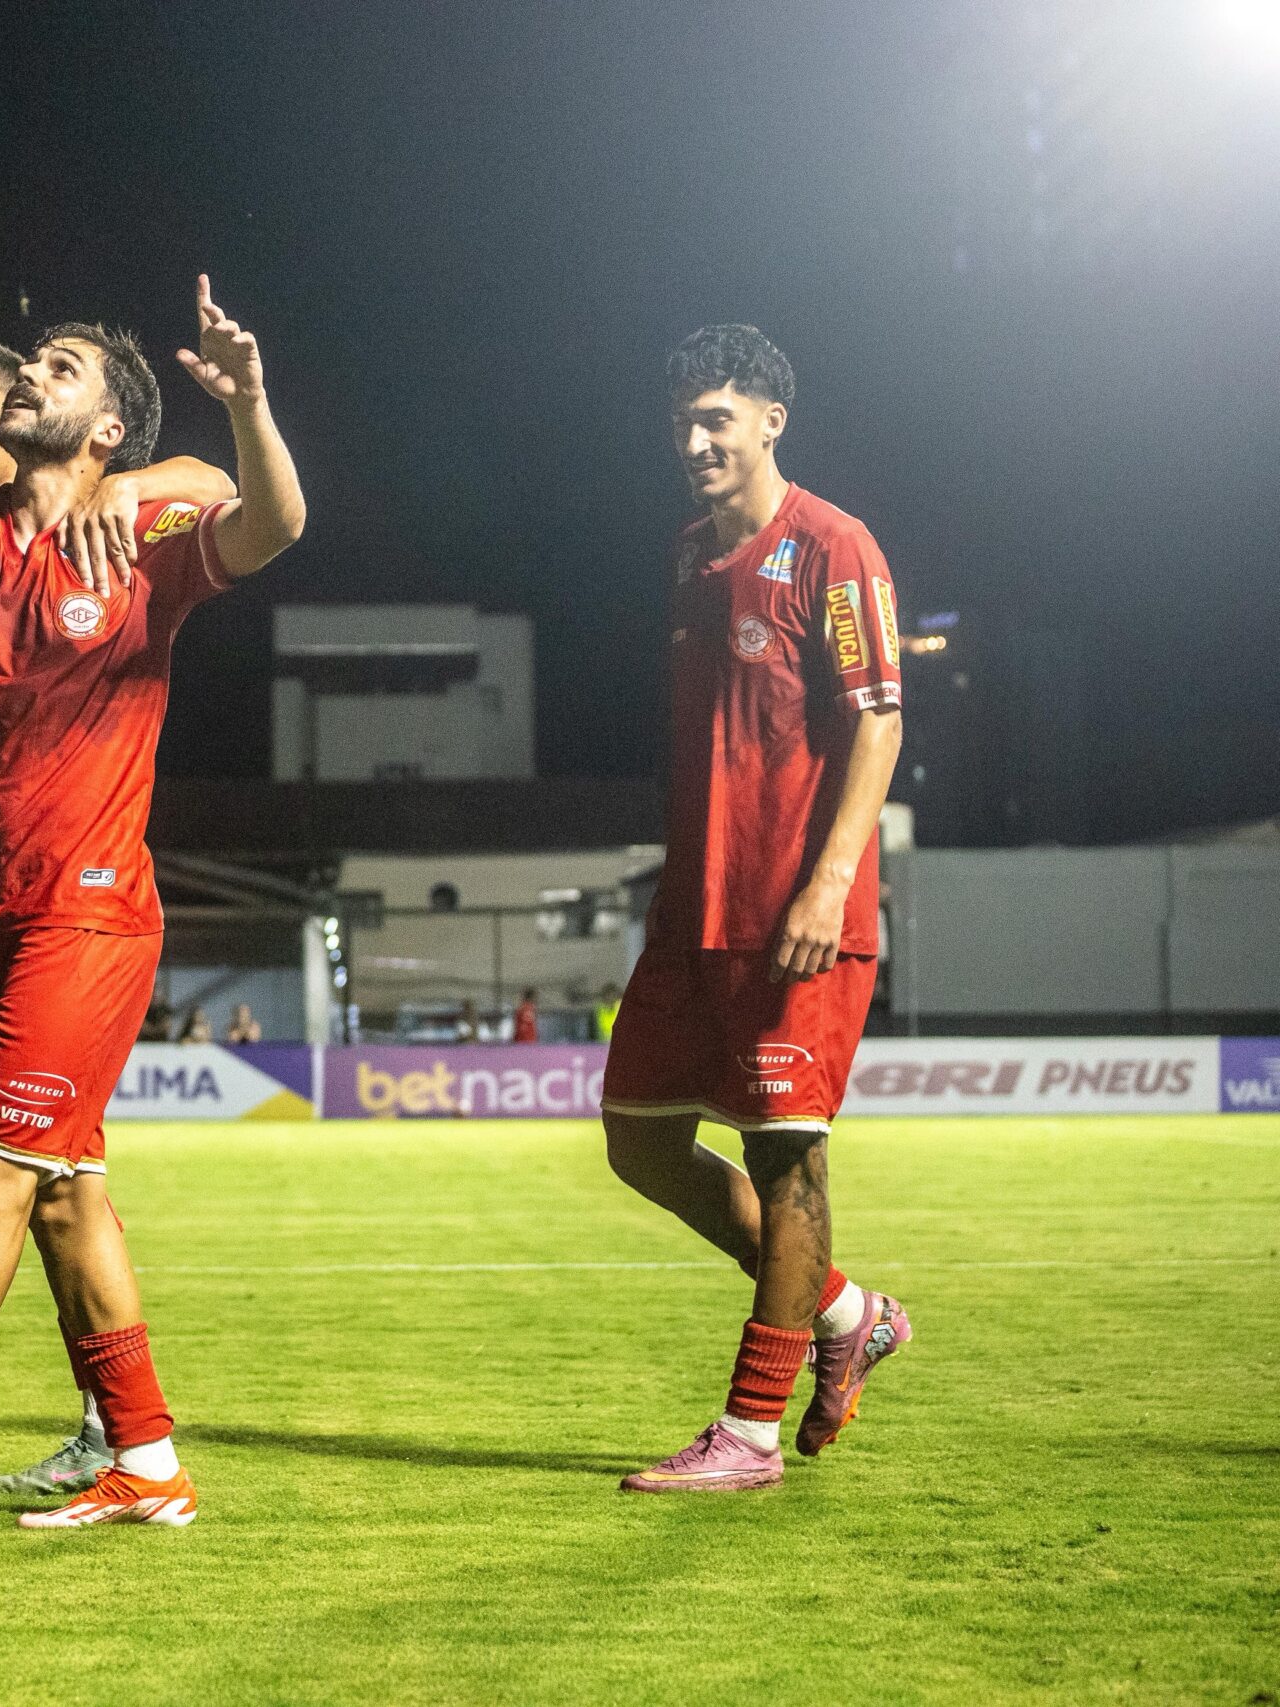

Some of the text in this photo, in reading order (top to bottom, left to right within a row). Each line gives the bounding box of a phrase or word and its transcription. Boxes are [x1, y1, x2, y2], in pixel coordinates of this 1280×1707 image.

[827, 587, 860, 668] DUJUCA
[9, 1080, 64, 1098] PHYSICUS
[1037, 1060, 1194, 1096] PNEUS
[0, 1105, 54, 1129] VETTOR
